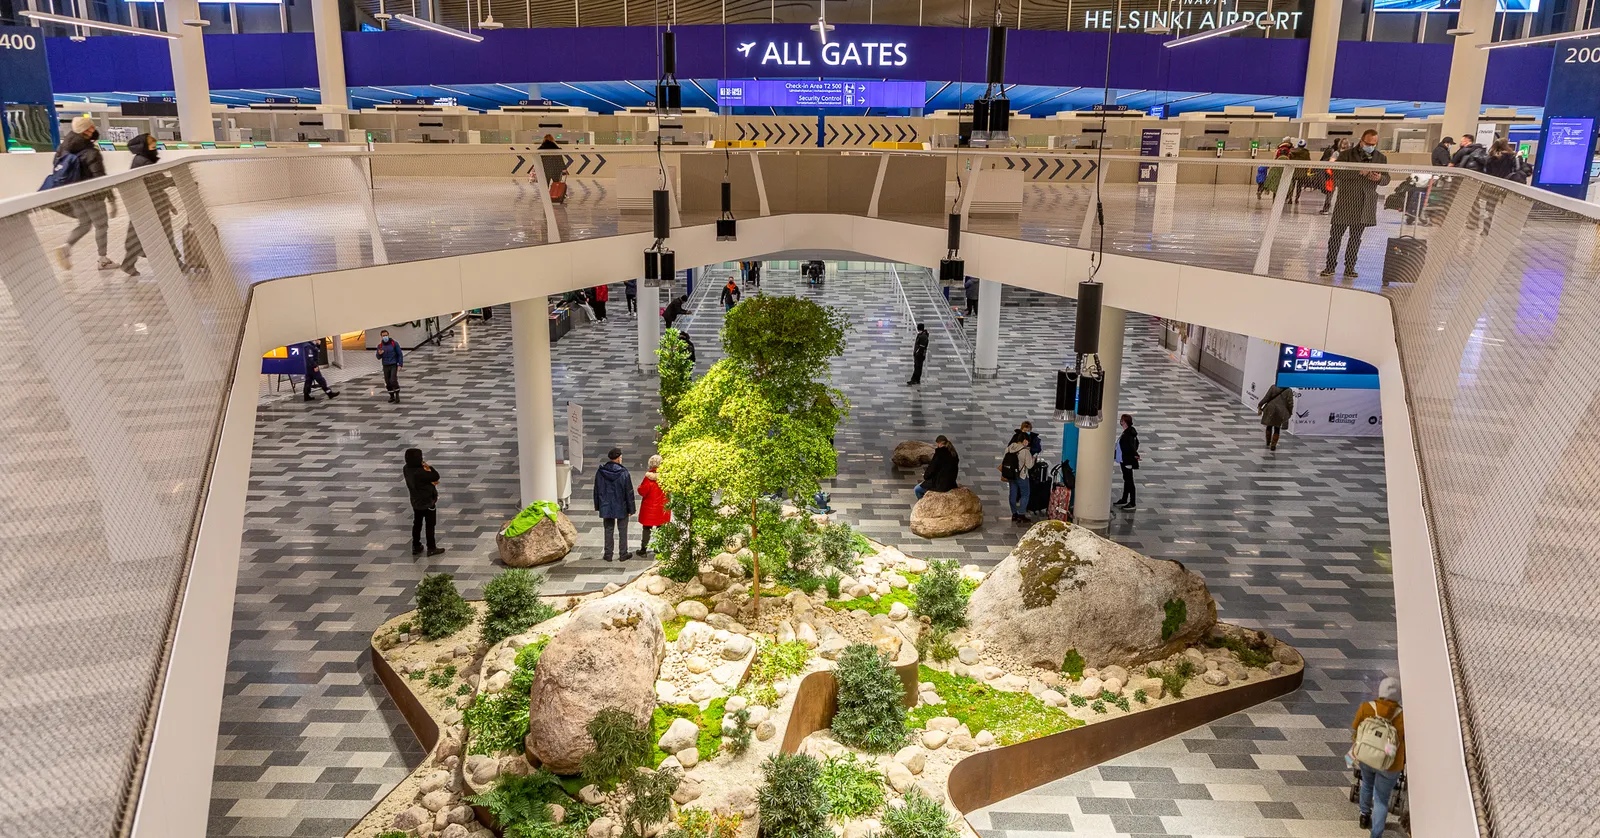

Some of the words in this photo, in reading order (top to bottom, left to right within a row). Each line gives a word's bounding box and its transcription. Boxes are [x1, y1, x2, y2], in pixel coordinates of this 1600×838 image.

[1084, 10, 1192, 29] HELSINKI
[1199, 10, 1304, 30] AIRPORT
[0, 34, 36, 50] 400
[761, 42, 811, 65] ALL
[821, 42, 908, 66] GATES
[1565, 47, 1600, 63] 200
